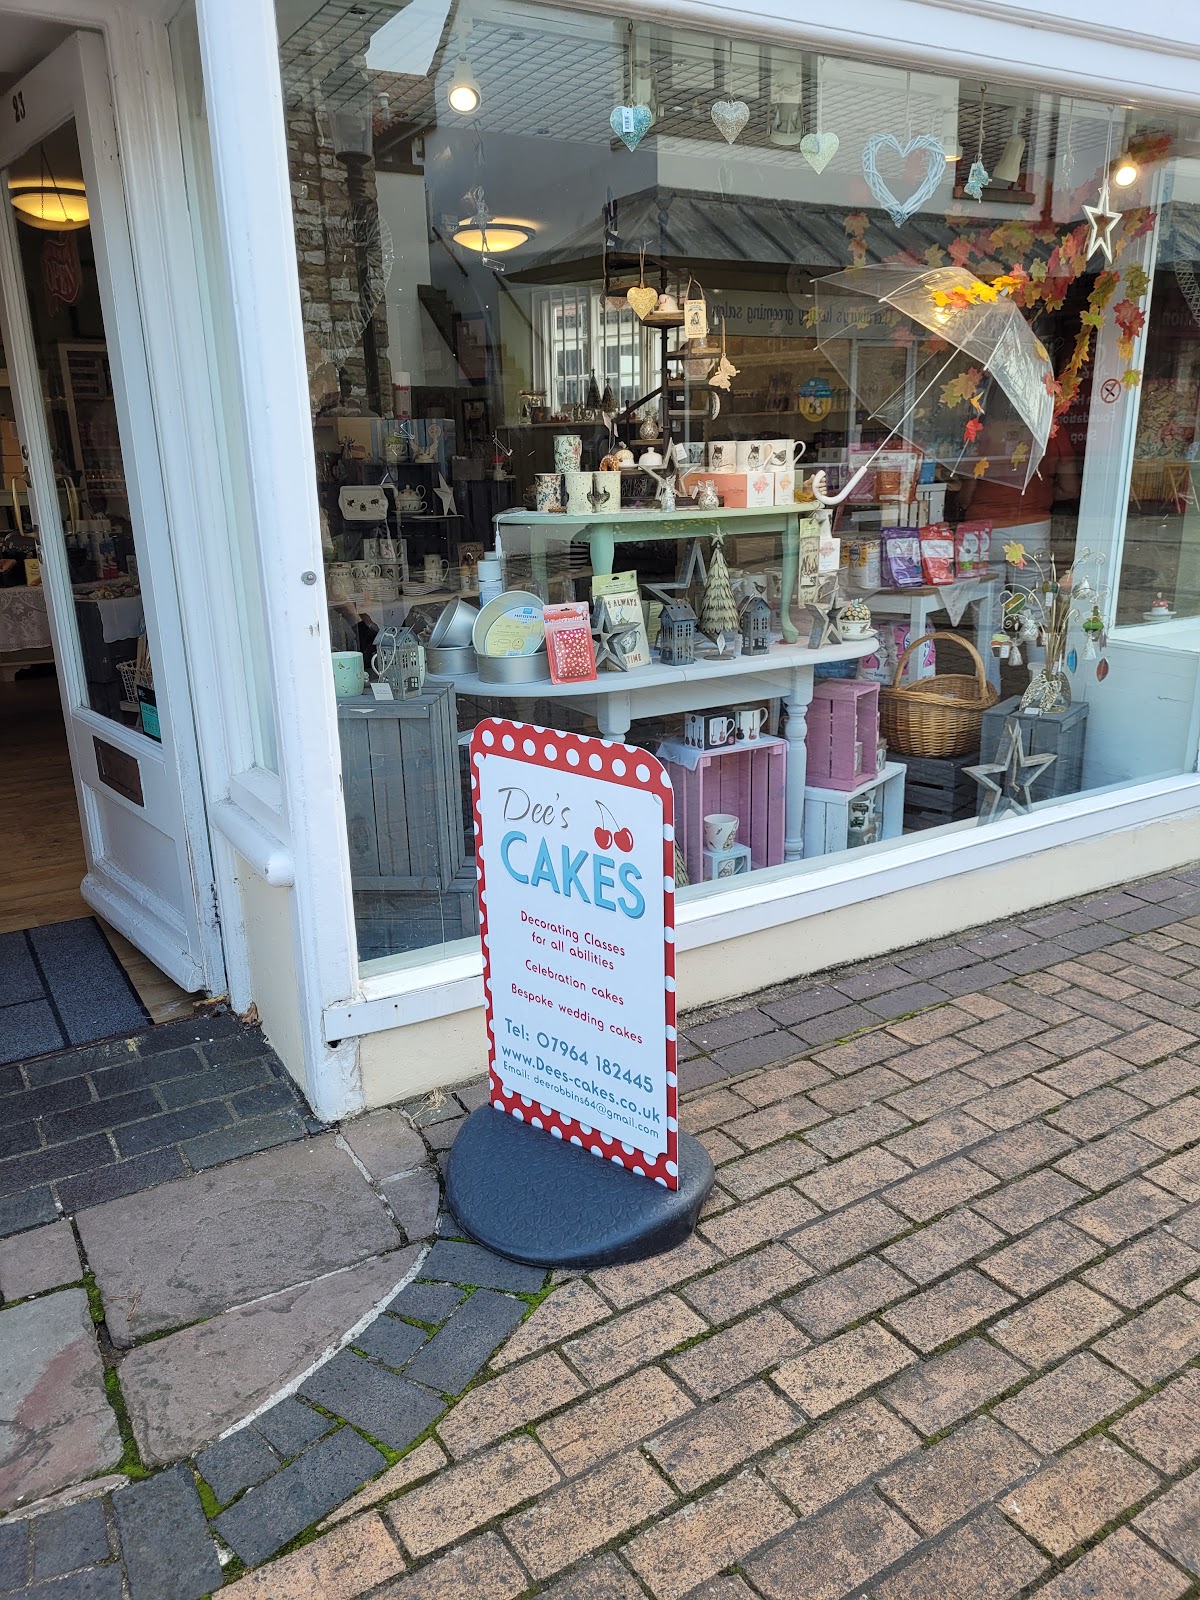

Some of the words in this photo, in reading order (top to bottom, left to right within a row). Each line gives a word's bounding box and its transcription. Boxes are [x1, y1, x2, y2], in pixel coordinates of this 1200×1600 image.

[613, 598, 637, 608] ALWAYS
[498, 787, 571, 829] Dee's
[500, 830, 646, 920] CAKES
[520, 909, 580, 944] Decorating
[584, 931, 626, 957] Classes
[531, 931, 546, 946] for
[550, 938, 565, 953] all
[569, 945, 614, 971] abilities
[525, 959, 586, 991] Celebration
[591, 982, 625, 1006] cakes
[511, 983, 553, 1009] Bespoke
[558, 1003, 604, 1032] wedding
[609, 1022, 643, 1045] cakes
[504, 1017, 530, 1042] Tel:
[536, 1031, 589, 1067] 07964
[596, 1055, 654, 1094] 182445
[501, 1045, 661, 1124] www.Dees-cakes.co.uk
[503, 1060, 530, 1080] Email:
[533, 1074, 659, 1139] deerobbins64@gmail.com
